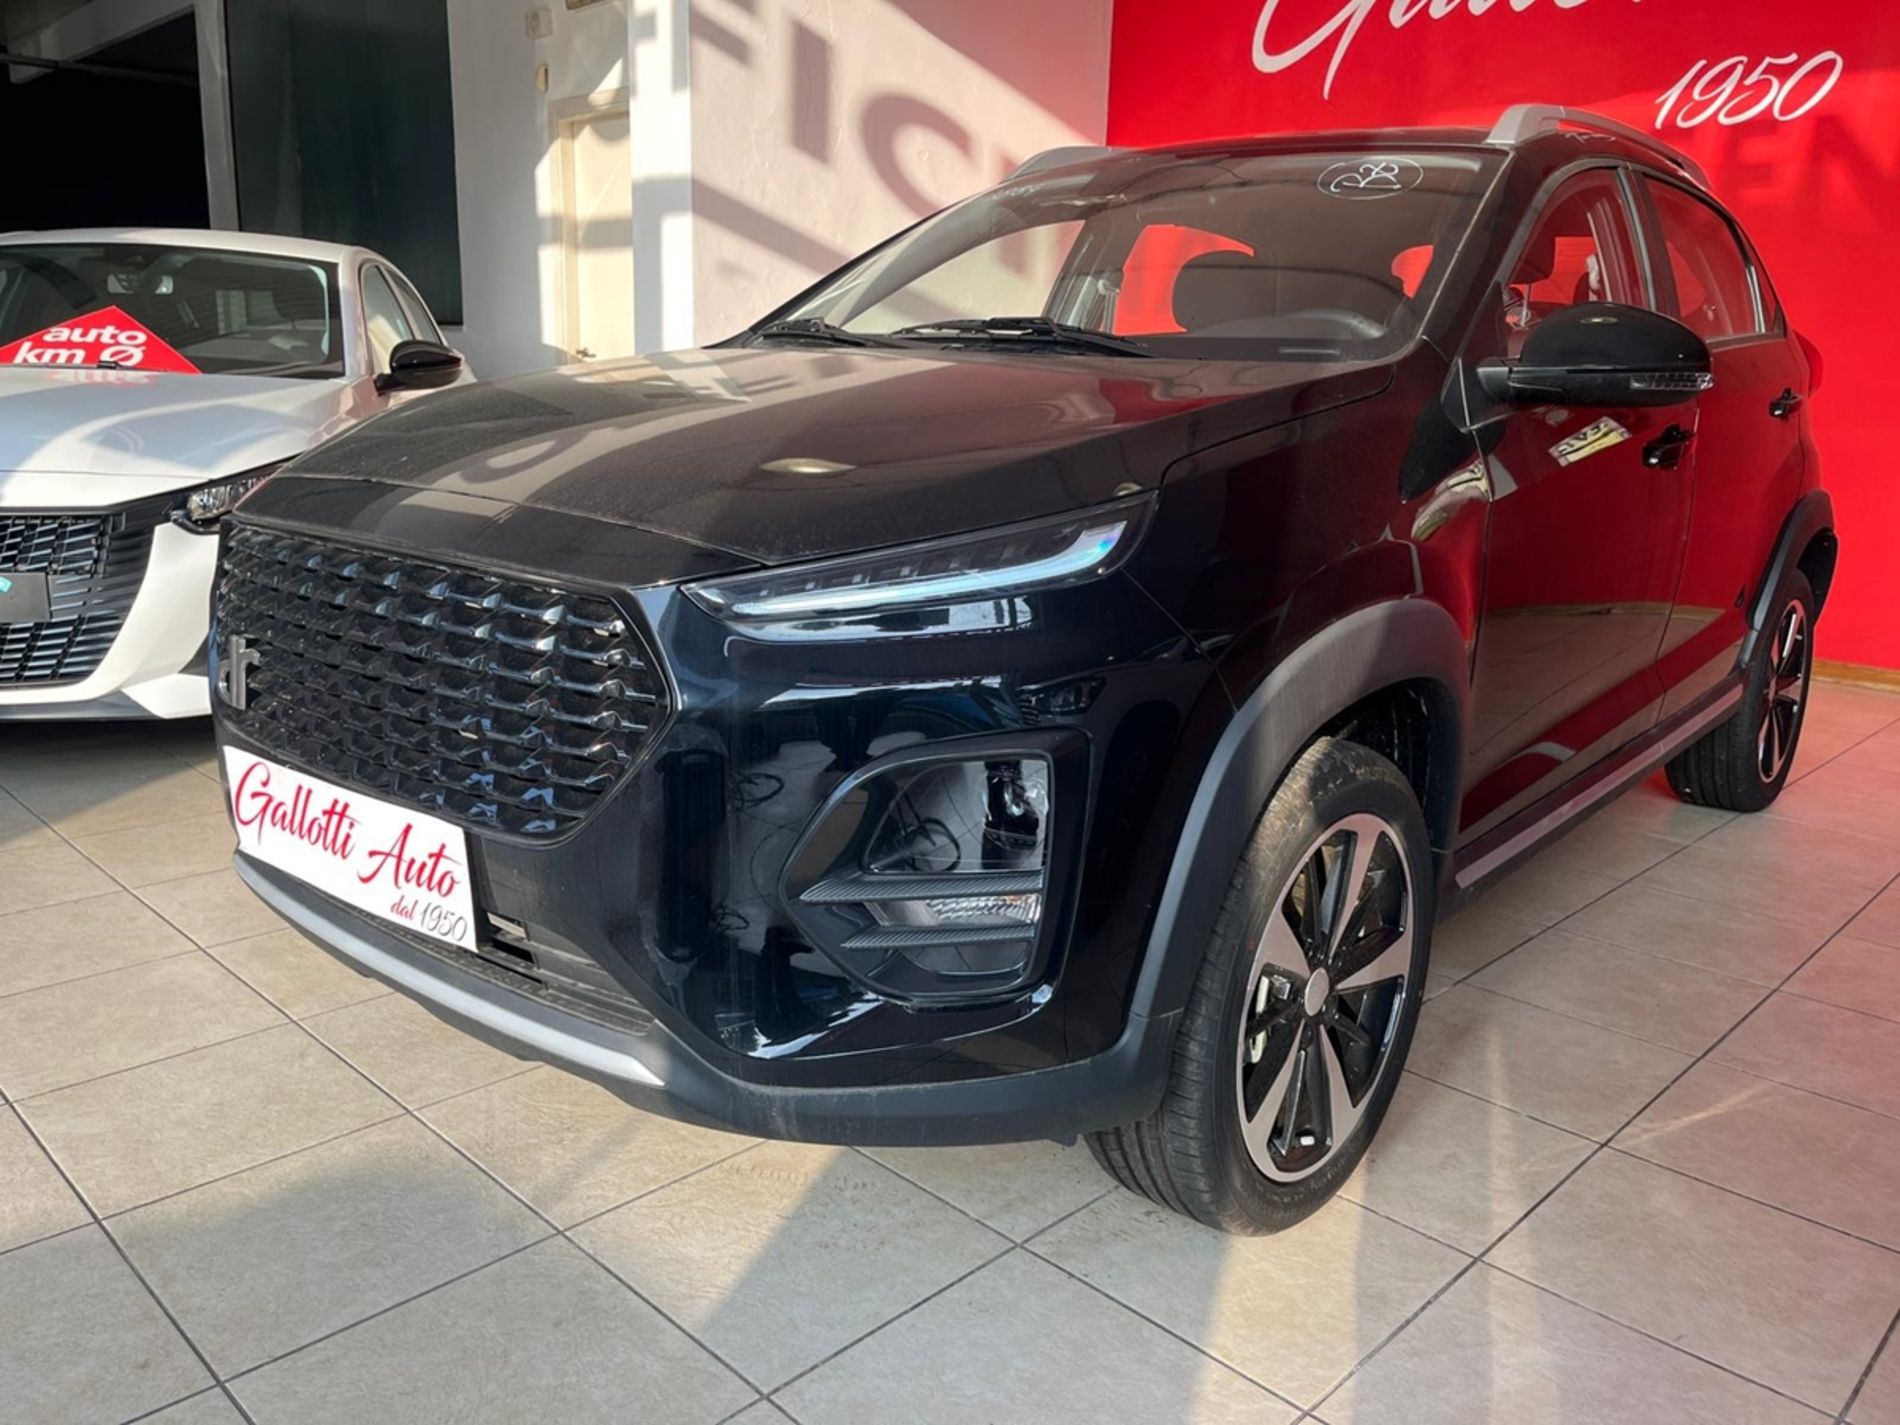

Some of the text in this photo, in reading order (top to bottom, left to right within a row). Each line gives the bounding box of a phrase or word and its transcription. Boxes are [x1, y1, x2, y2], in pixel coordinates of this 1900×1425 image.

[1655, 50, 1843, 130] 1950
[13, 341, 86, 364] km
[42, 325, 147, 345] auto
[235, 761, 464, 898] Gallotti Auto
[390, 895, 468, 942] dal 1950
